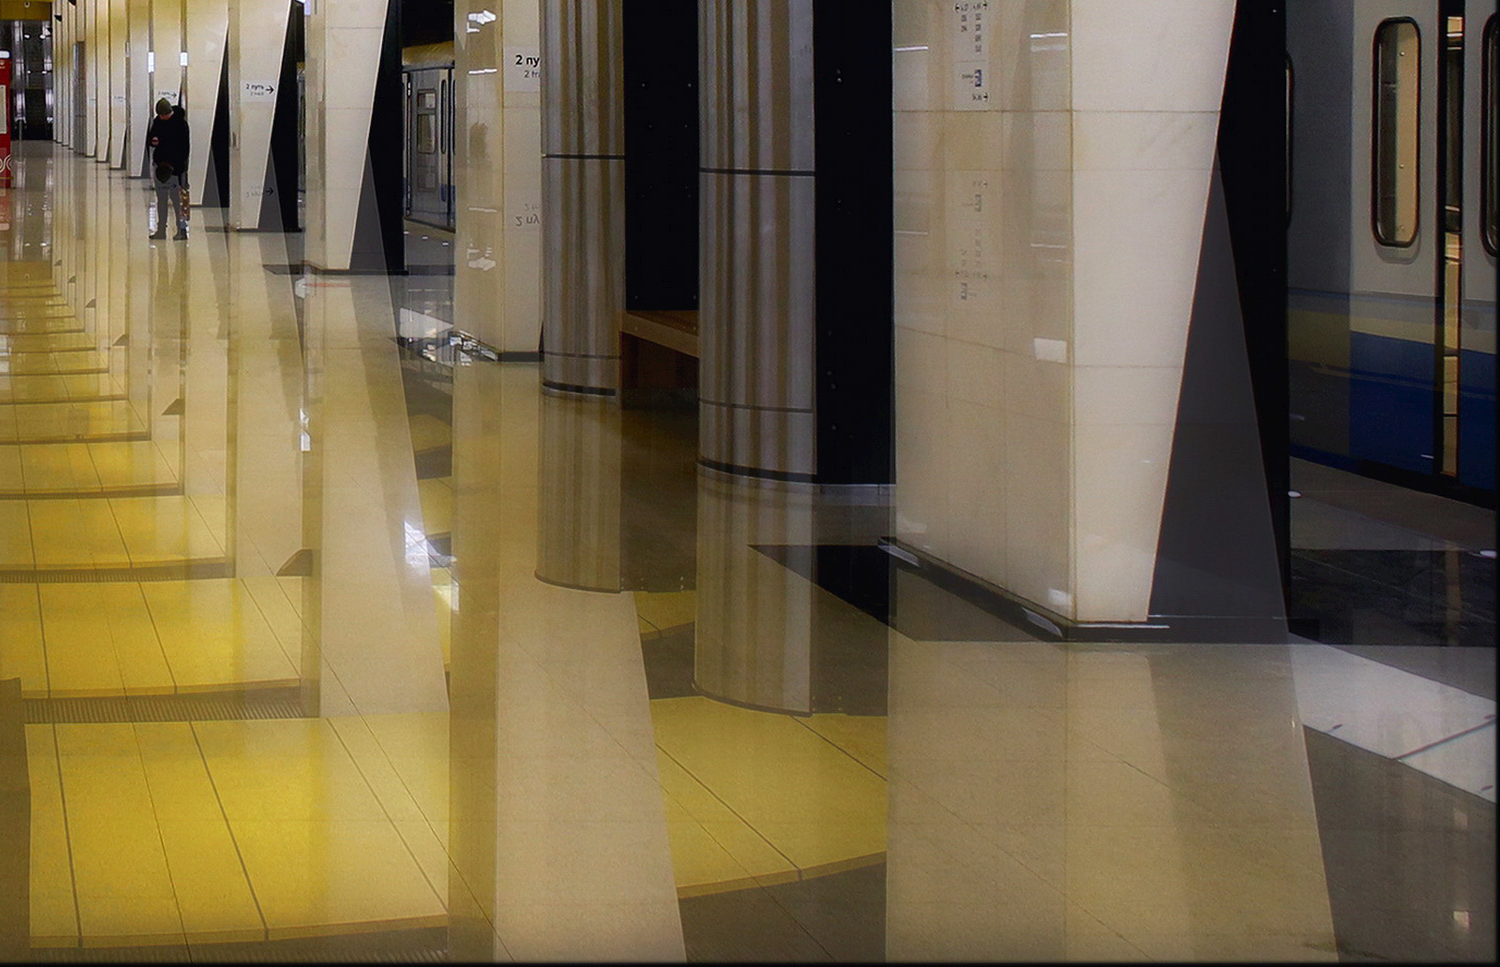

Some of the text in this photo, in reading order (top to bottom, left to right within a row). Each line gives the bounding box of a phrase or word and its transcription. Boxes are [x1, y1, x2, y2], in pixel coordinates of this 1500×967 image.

[515, 54, 541, 68] 2 пу
[524, 70, 541, 78] 2 tr
